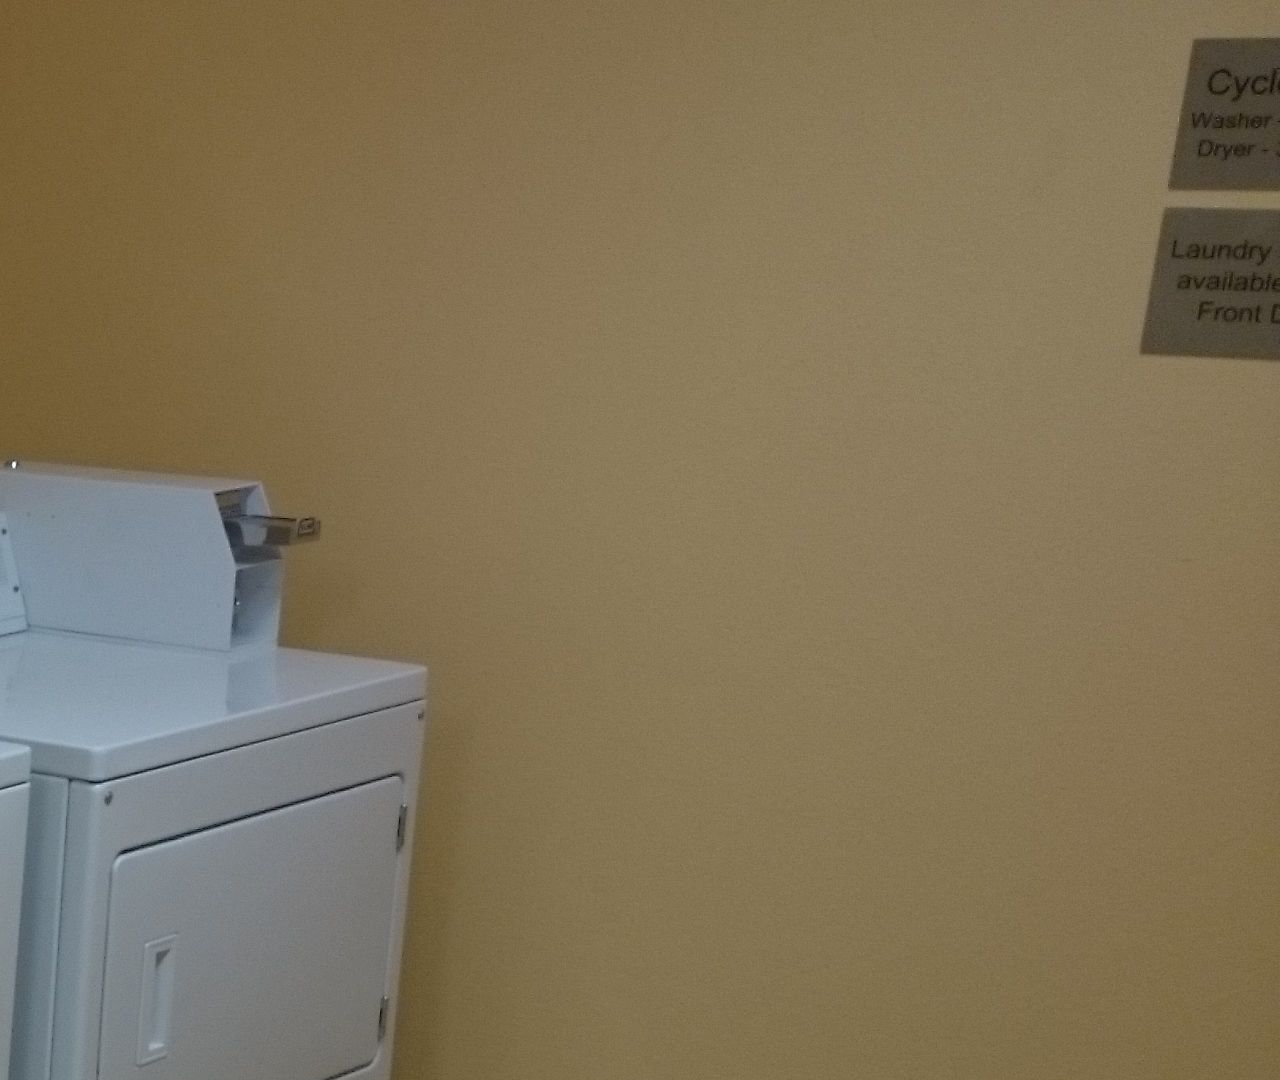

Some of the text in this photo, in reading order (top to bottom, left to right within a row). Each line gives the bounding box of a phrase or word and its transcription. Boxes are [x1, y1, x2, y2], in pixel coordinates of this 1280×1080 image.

[1207, 68, 1280, 102] Cycl
[1192, 111, 1274, 129] Washer
[1198, 139, 1256, 161] Dryer
[1171, 239, 1273, 266] Laundry
[1197, 300, 1262, 323] Front
